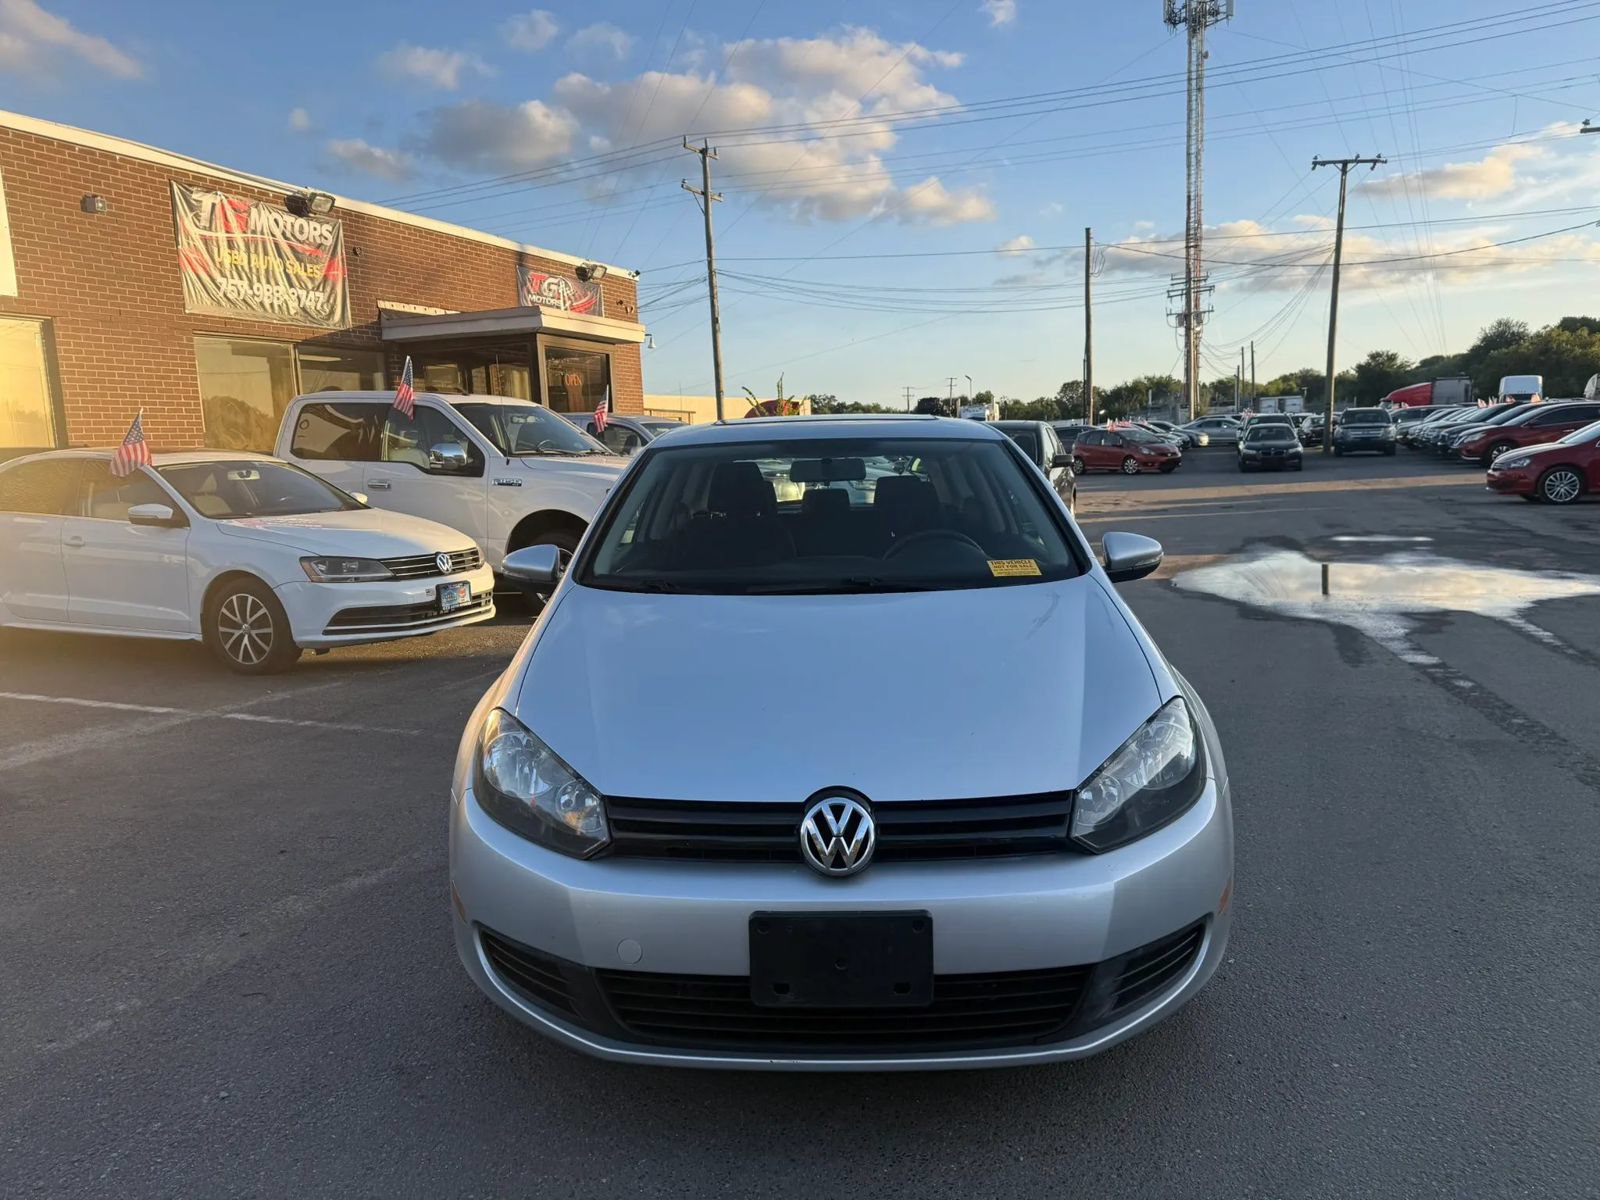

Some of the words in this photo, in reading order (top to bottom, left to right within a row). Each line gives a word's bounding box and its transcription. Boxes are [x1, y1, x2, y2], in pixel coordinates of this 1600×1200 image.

[250, 205, 333, 245] MOTORS
[286, 260, 321, 279] SALES
[528, 294, 562, 307] MOTORS
[801, 797, 875, 876] VW
